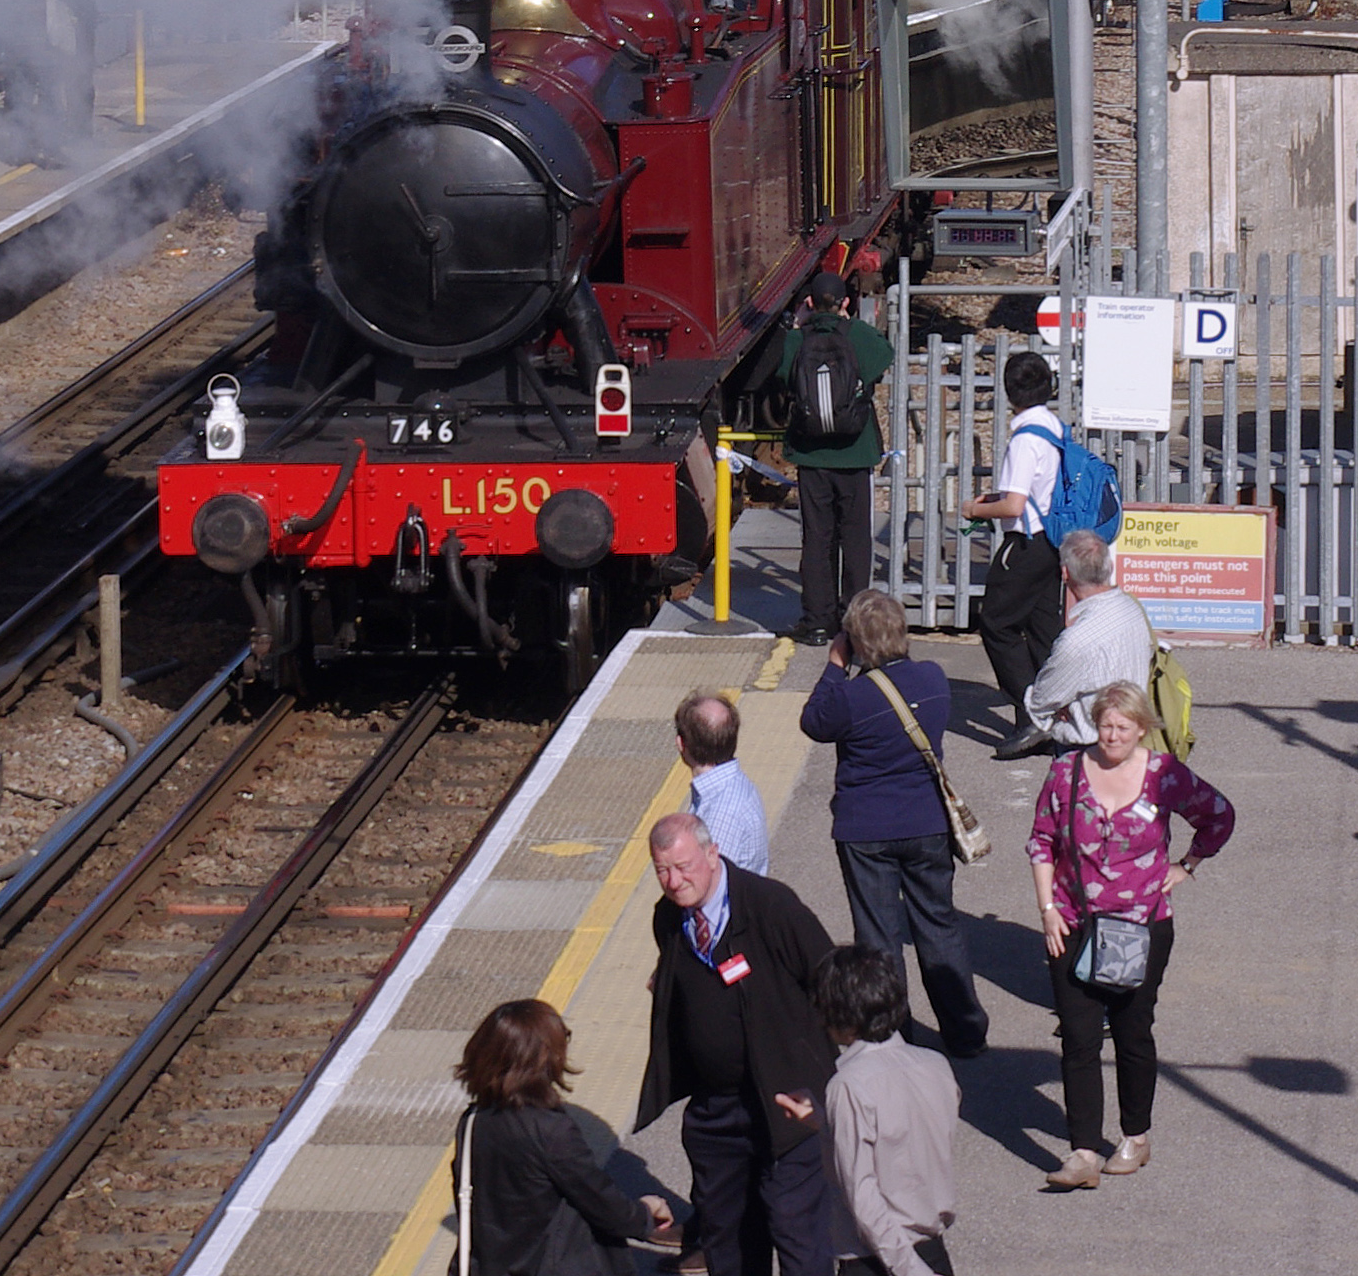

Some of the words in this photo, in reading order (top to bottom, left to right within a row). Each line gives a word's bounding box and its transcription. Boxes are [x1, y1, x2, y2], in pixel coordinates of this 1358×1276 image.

[1097, 302, 1118, 311] Train
[1119, 304, 1155, 313] operator
[1096, 312, 1146, 321] information
[1197, 308, 1227, 343] D
[1215, 347, 1234, 355] OFF
[390, 418, 454, 443] 746
[442, 477, 552, 515] L.150
[1124, 517, 1180, 535] Danger
[1124, 535, 1151, 549] High
[1154, 536, 1199, 550] voltage
[1123, 557, 1190, 572] Passengers
[1192, 560, 1225, 571] must
[1227, 561, 1249, 571] not
[1123, 572, 1151, 584] pass
[1153, 571, 1178, 583] this
[1180, 572, 1213, 585] point
[1123, 584, 1167, 594] Offenders
[1168, 585, 1184, 594] will
[1185, 586, 1197, 595] be
[1198, 587, 1246, 597] prosecuted
[1180, 606, 1193, 614] on
[1193, 606, 1209, 614] the
[1210, 606, 1232, 615] track
[1233, 607, 1255, 615] must
[1154, 614, 1174, 622] with
[1175, 614, 1203, 625] safety
[1203, 614, 1255, 624] instructions
